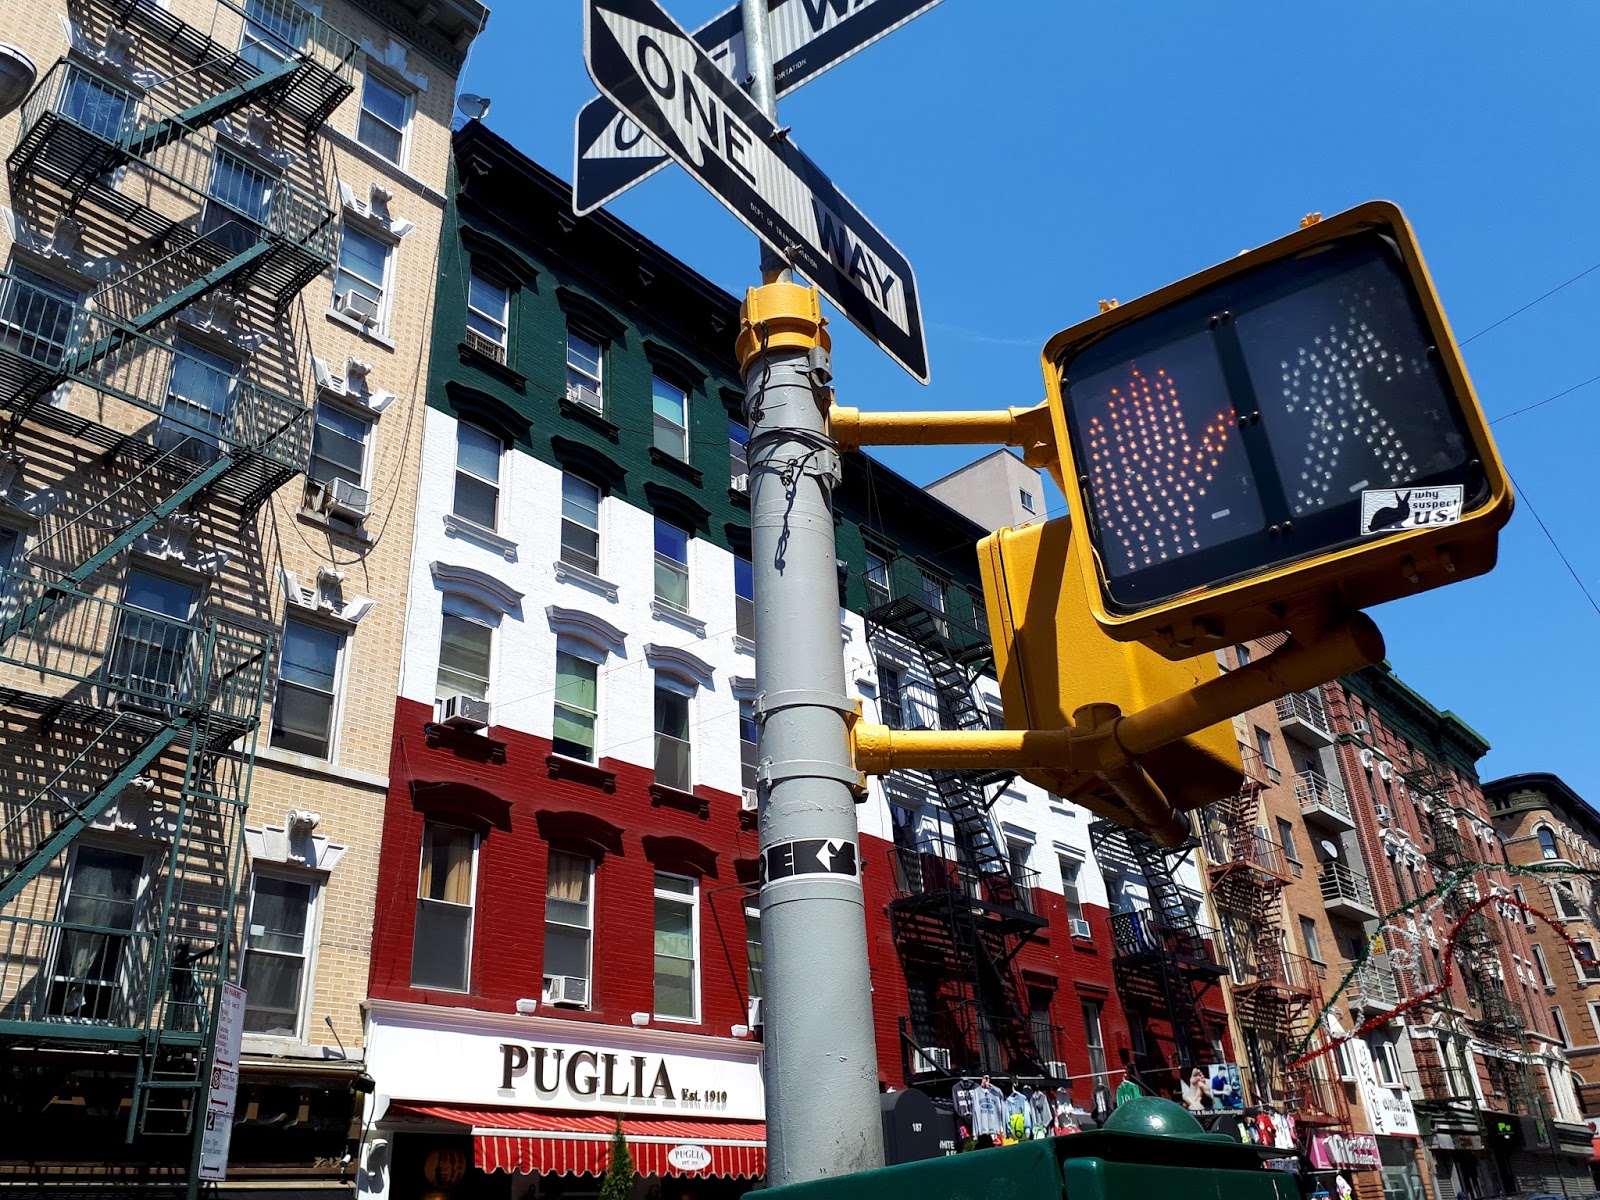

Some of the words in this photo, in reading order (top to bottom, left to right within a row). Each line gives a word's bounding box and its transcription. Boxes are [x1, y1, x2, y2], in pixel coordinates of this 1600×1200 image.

[637, 35, 757, 186] ONE
[811, 197, 895, 312] WAY
[1414, 490, 1439, 500] why
[1412, 499, 1457, 510] suspect
[1413, 509, 1456, 525] us.
[498, 1043, 677, 1101] PUGLIA
[912, 1122, 922, 1132] 187
[675, 1149, 705, 1161] PUGLIA
